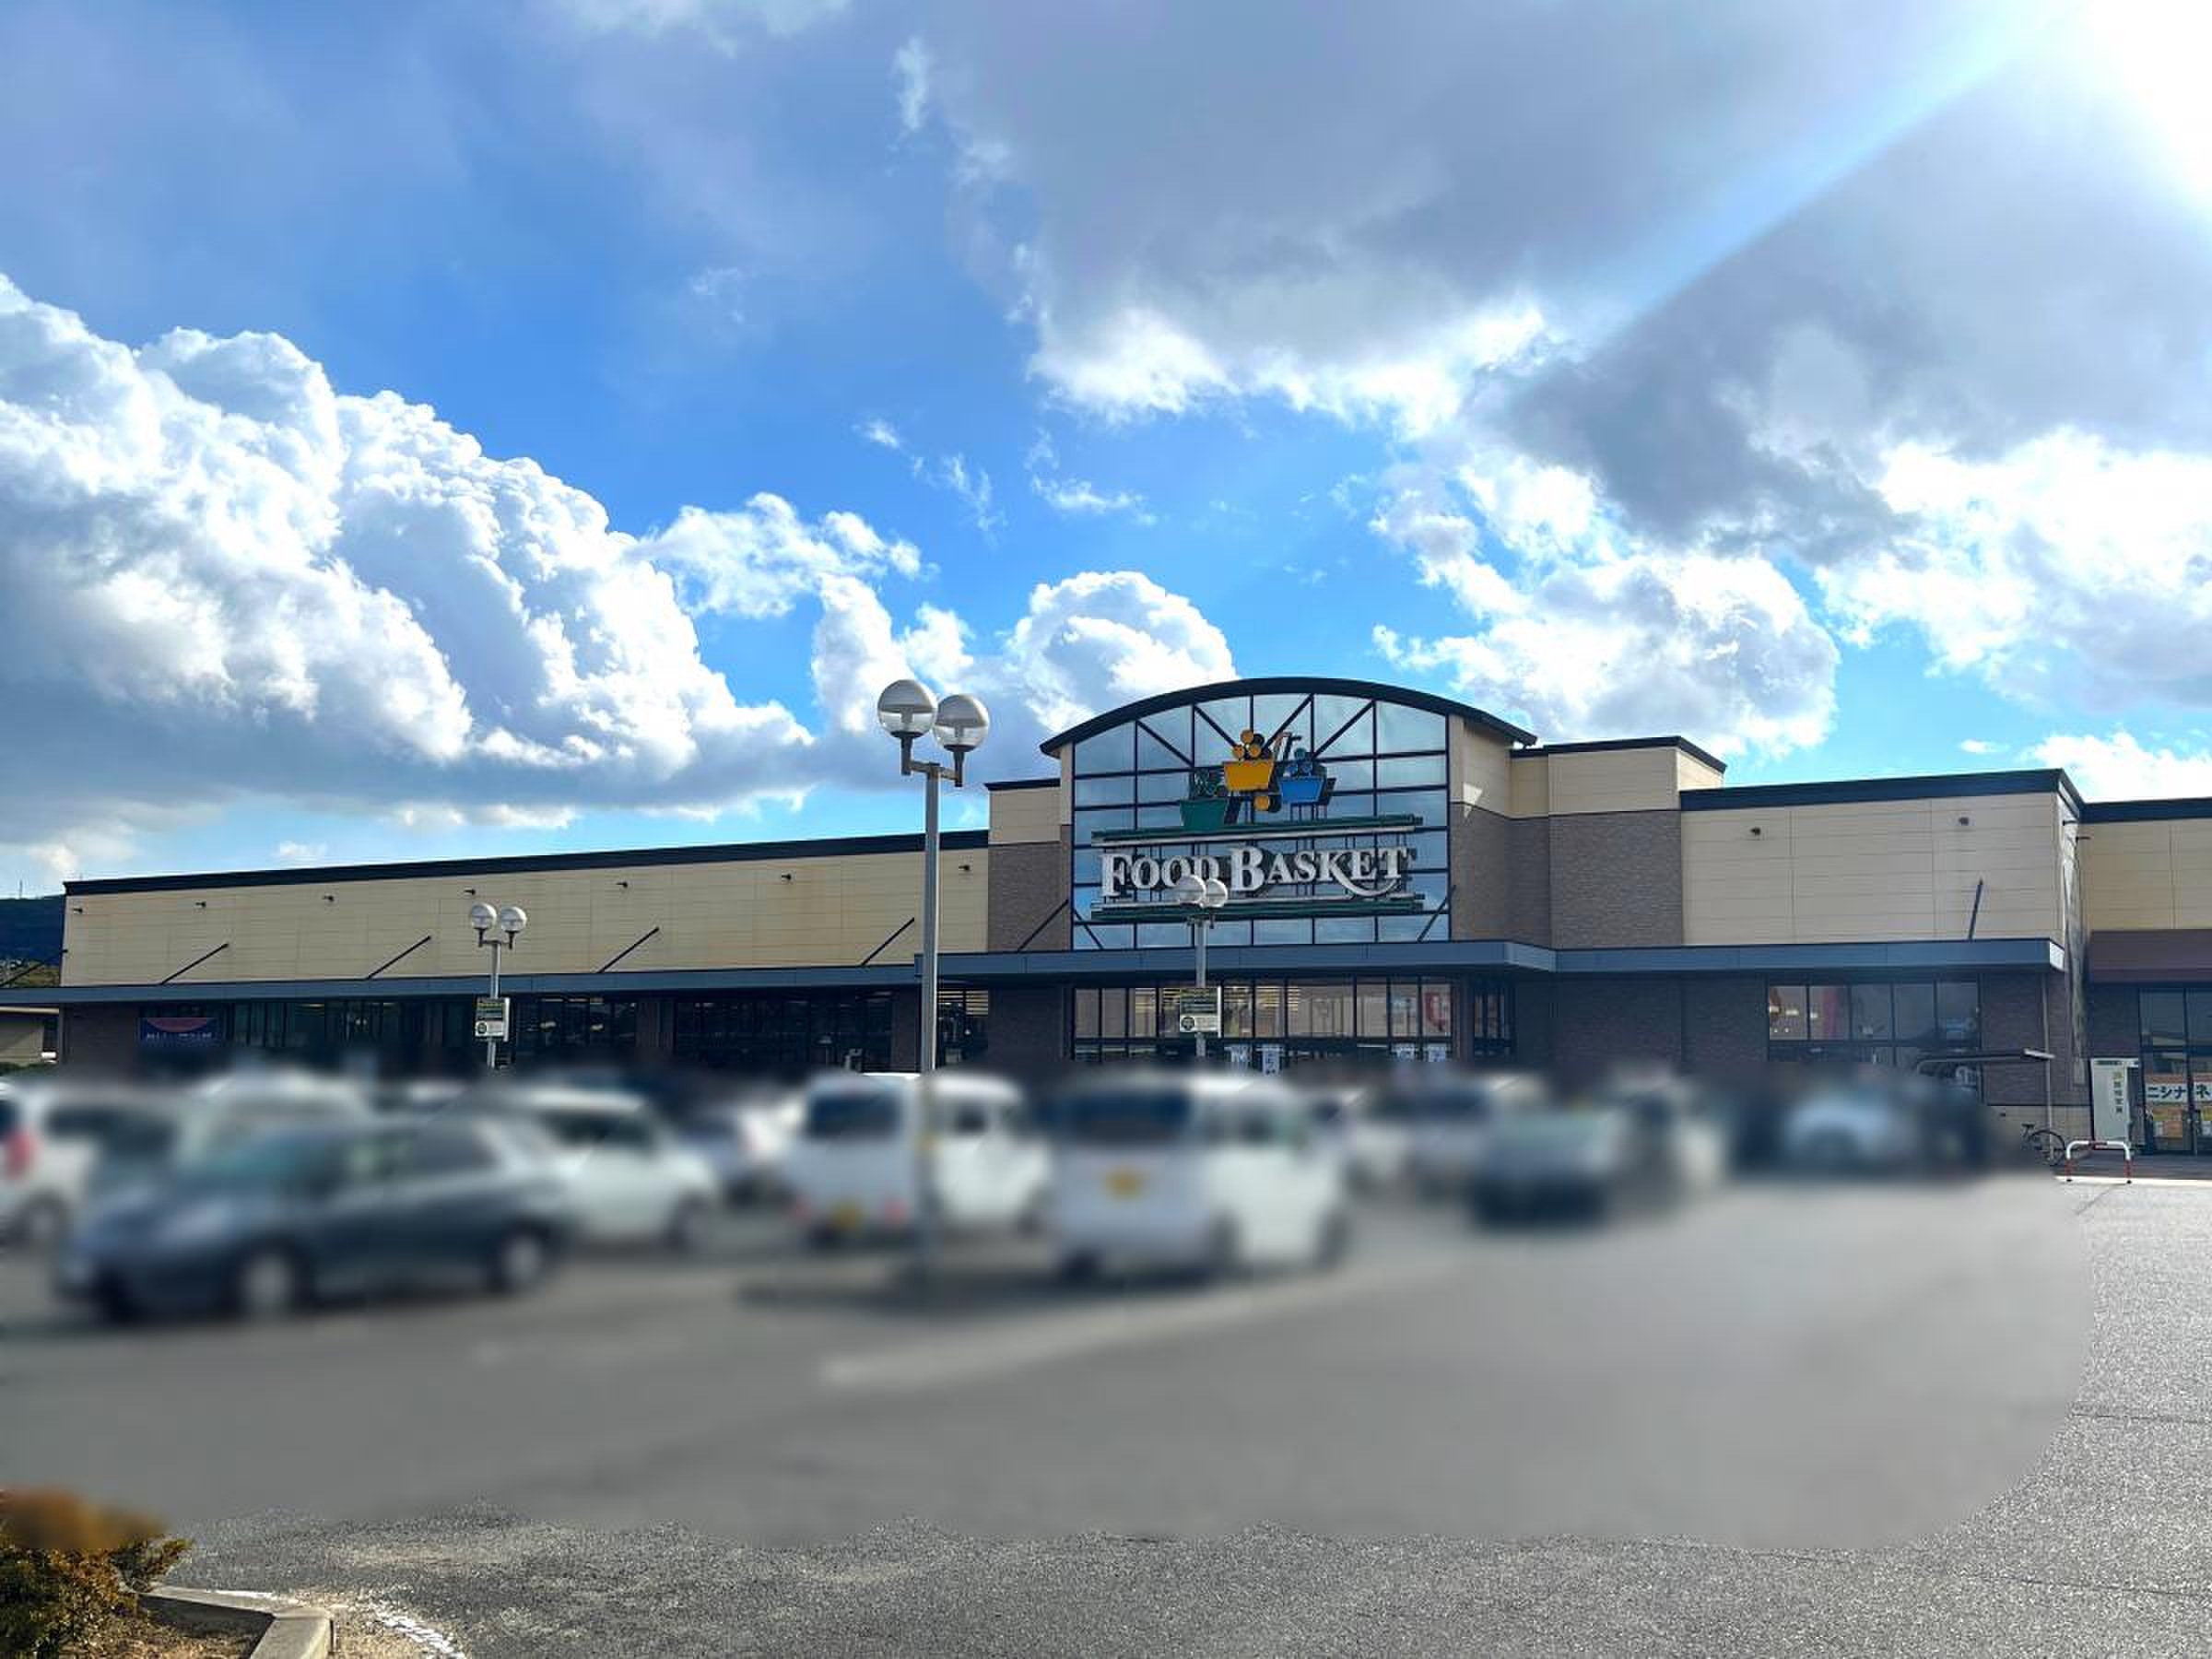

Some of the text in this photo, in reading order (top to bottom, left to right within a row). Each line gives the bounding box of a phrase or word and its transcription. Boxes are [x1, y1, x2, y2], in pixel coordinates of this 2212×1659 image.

[1100, 845, 1409, 897] FOOD BASKET
[2147, 1085, 2186, 1100] ニシナ
